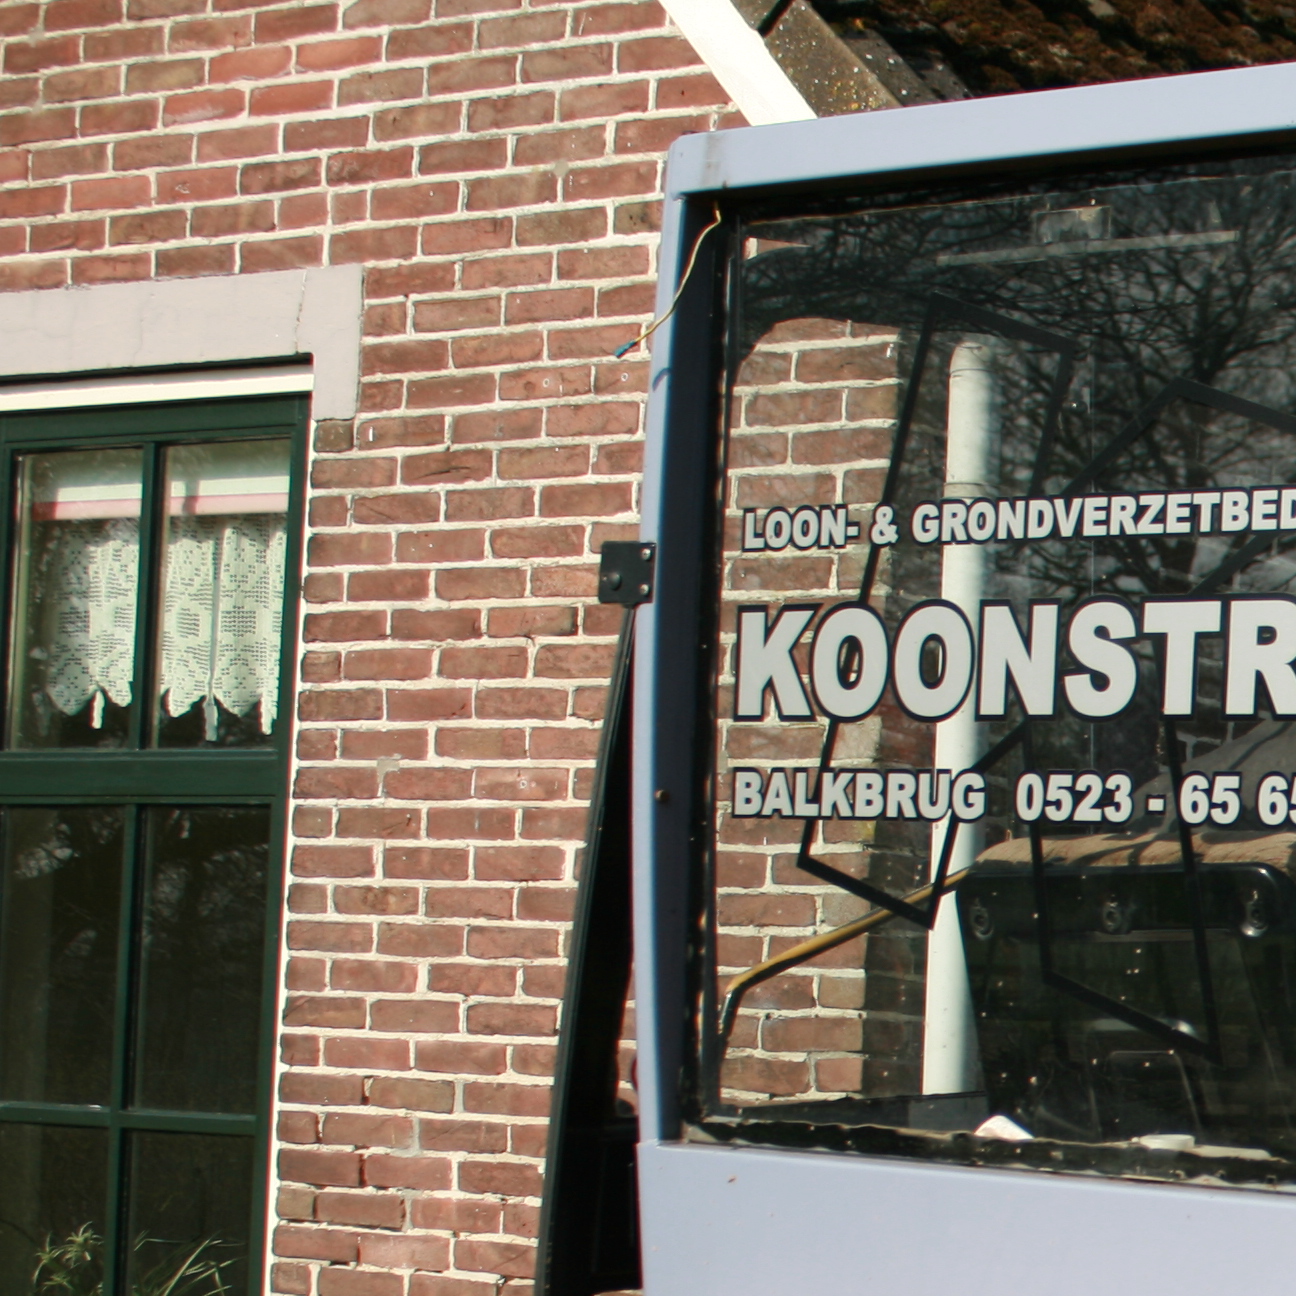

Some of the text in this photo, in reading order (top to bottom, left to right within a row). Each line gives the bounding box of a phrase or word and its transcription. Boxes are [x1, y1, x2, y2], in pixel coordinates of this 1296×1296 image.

[743, 506, 859, 550] LOON-
[870, 506, 899, 544] &
[733, 769, 986, 821] BALKBRUG
[1016, 774, 1132, 823] 0523
[1181, 775, 1239, 823] 65
